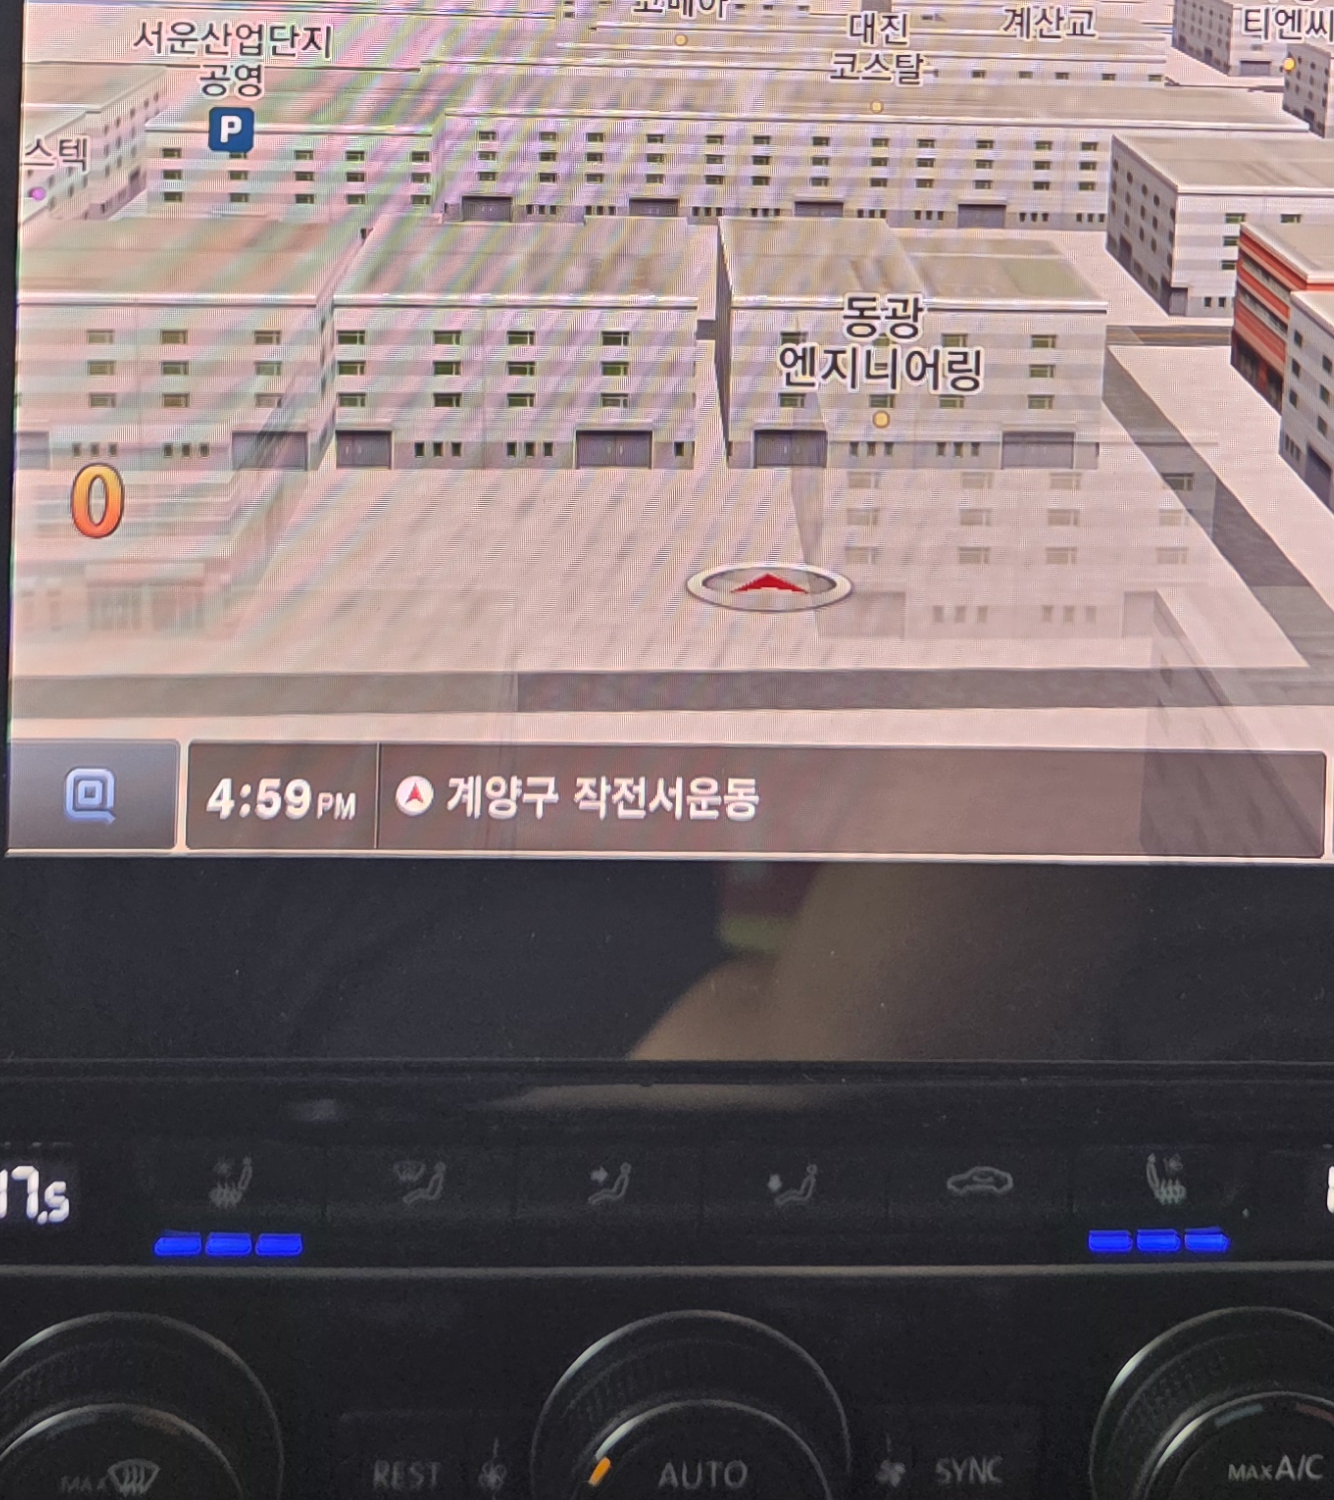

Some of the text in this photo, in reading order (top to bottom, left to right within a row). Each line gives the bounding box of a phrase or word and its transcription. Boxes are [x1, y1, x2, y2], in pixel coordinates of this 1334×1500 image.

[134, 20, 334, 58] 서운산업단지
[849, 13, 909, 46] 대진
[1003, 7, 1097, 39] 계산교
[1244, 8, 1334, 43] 티엔씨
[199, 64, 264, 98] 공영
[831, 52, 924, 85] 코스탈
[843, 296, 924, 339] 동광
[779, 347, 983, 392] 엔지니어링
[70, 462, 125, 539] 0
[447, 776, 760, 821] 계양구 작전서운동
[373, 1460, 442, 1493] REST
[658, 1460, 748, 1490] AUTO
[934, 1456, 1006, 1485] SYNC
[1274, 1453, 1324, 1483] A/C
